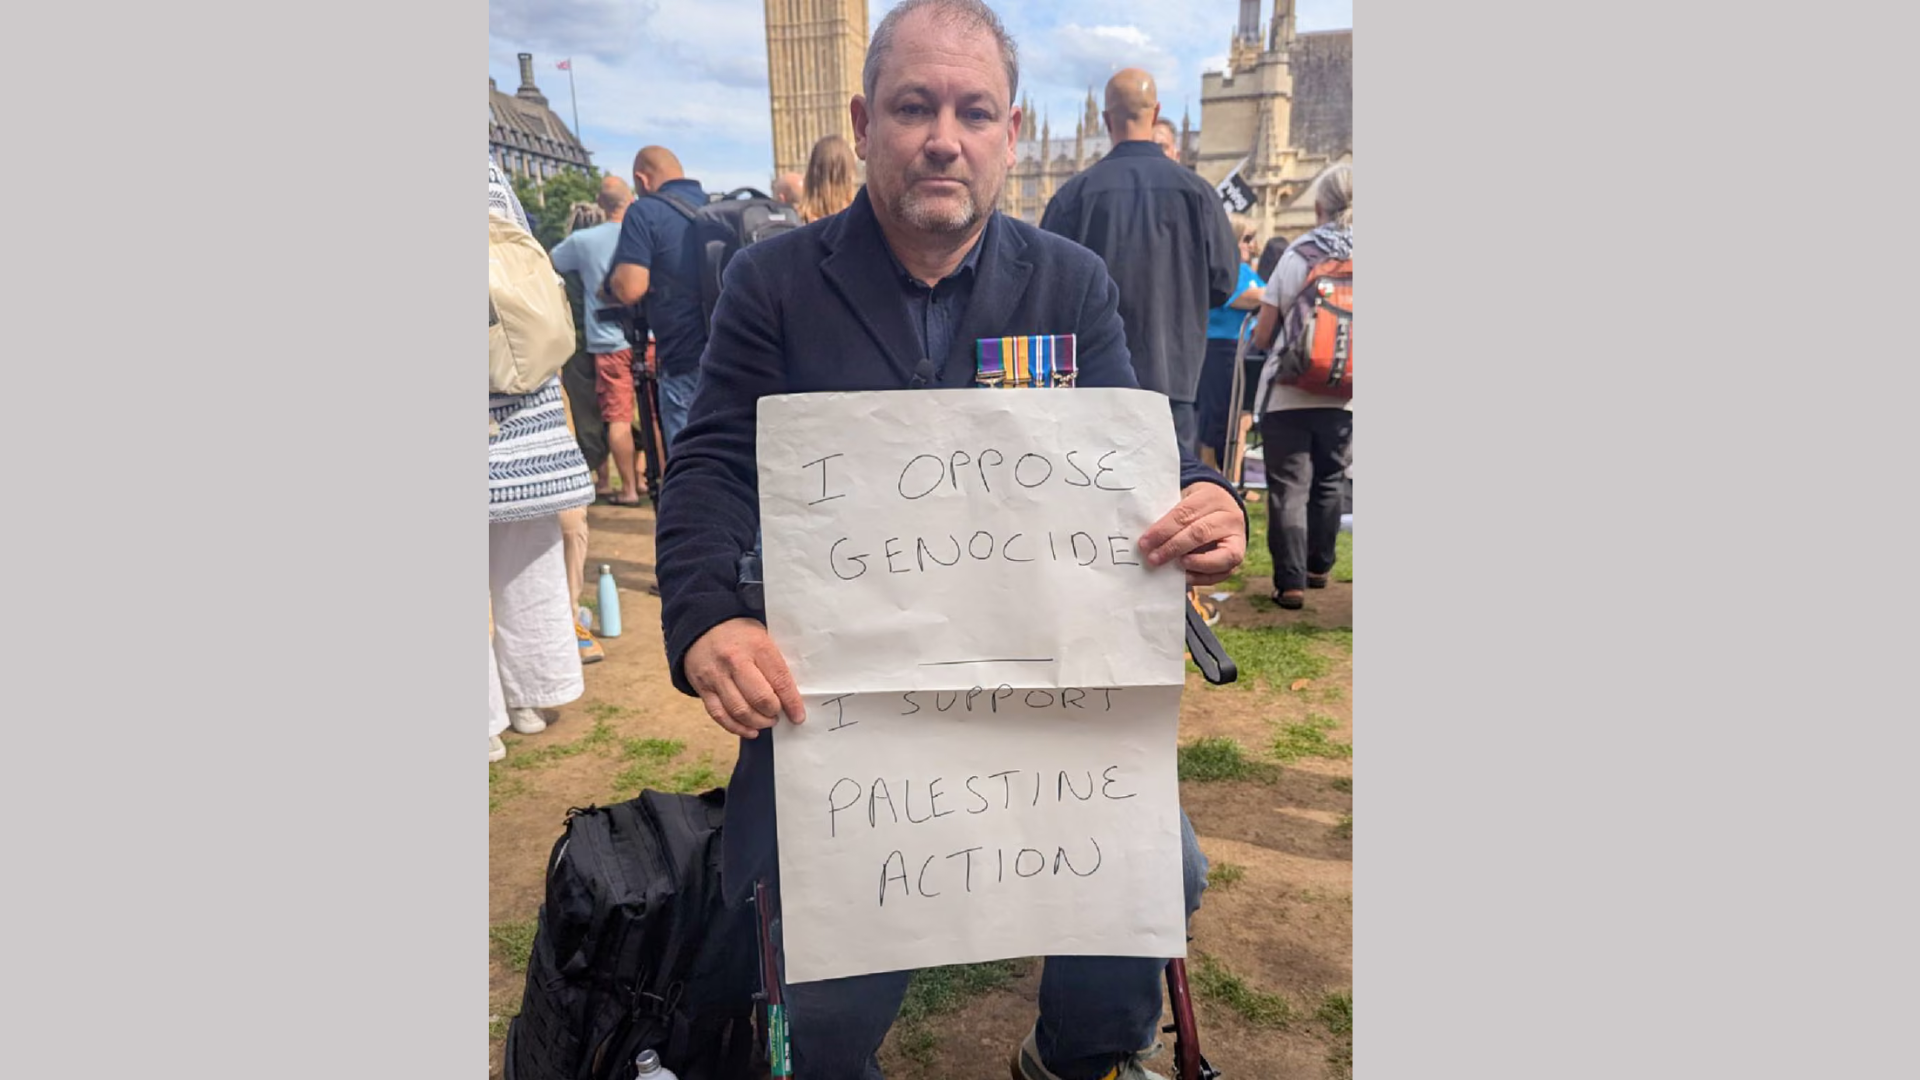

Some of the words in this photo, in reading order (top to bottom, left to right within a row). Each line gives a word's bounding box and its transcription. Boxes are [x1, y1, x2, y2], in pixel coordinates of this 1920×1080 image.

[801, 452, 845, 506] I
[898, 448, 1136, 500] OPPOSE
[830, 529, 1140, 580] GENOCIDE
[821, 692, 859, 731] I
[900, 684, 1123, 716] SUPPORT
[828, 765, 1137, 838] PALESTINE
[879, 837, 1102, 907] ACTION
